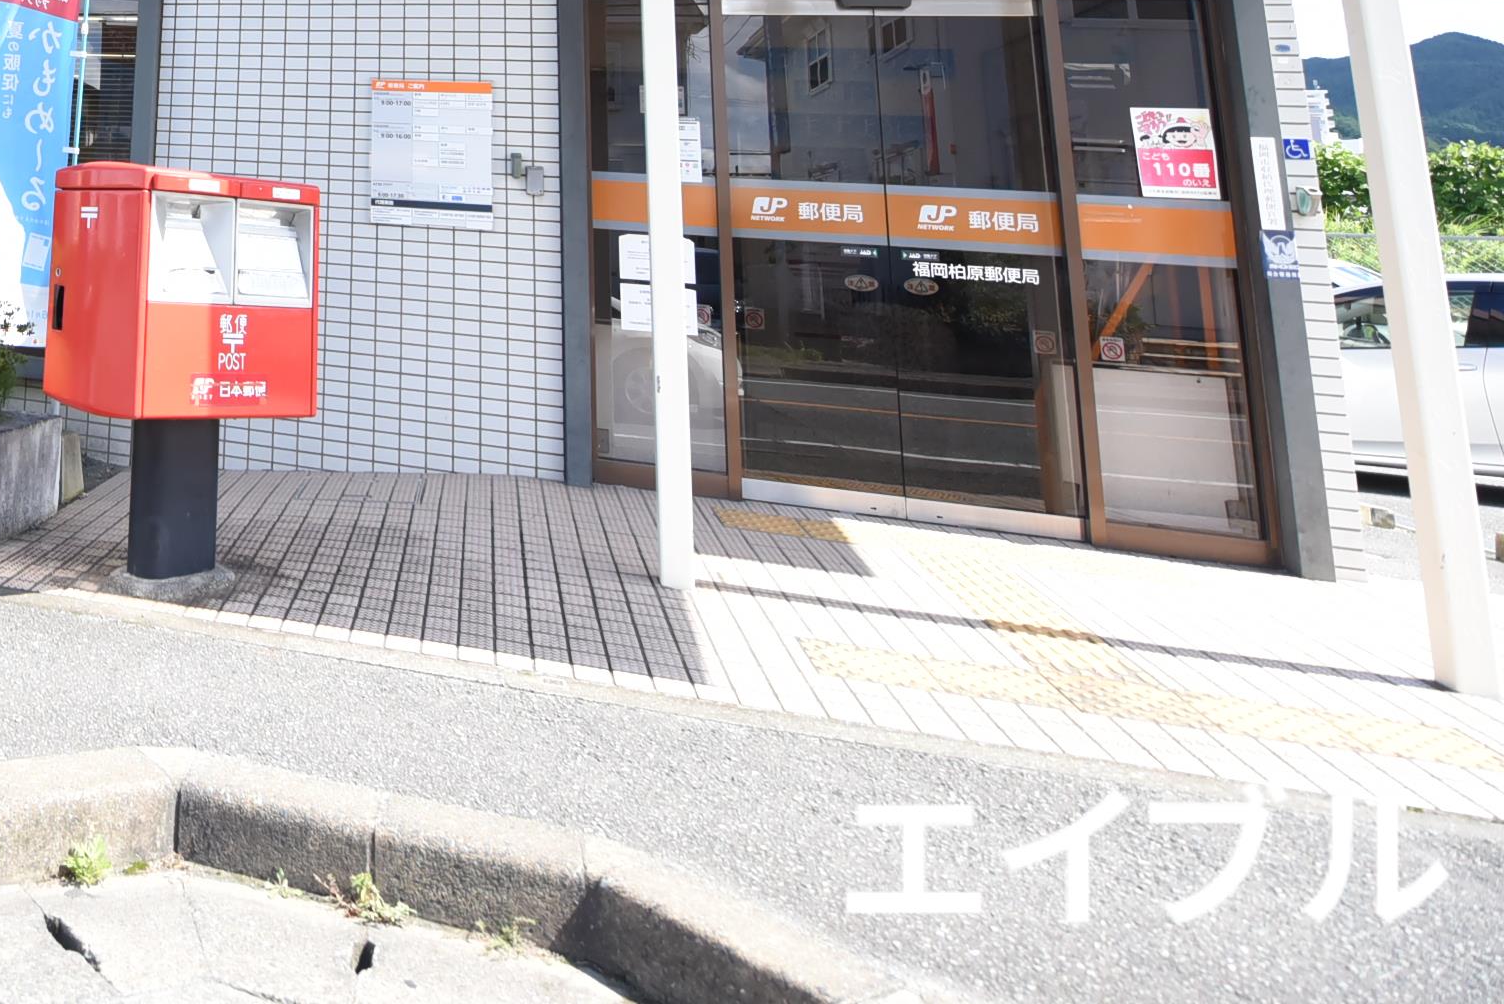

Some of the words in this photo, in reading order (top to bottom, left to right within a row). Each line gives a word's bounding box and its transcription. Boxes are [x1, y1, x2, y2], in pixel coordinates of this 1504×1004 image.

[1142, 152, 1170, 161] こども
[1152, 162, 1210, 178] 110番
[1183, 179, 1212, 188] のいえ
[752, 196, 789, 216] JP
[798, 202, 863, 224] 郵便局
[919, 204, 957, 223] JP
[750, 215, 785, 223] NETWORK
[917, 223, 955, 232] NETWORK
[969, 210, 1039, 234] 郵便局
[912, 260, 1040, 286] 福岡柏原郵便局
[219, 313, 248, 334] 郵便
[218, 352, 247, 371] POST
